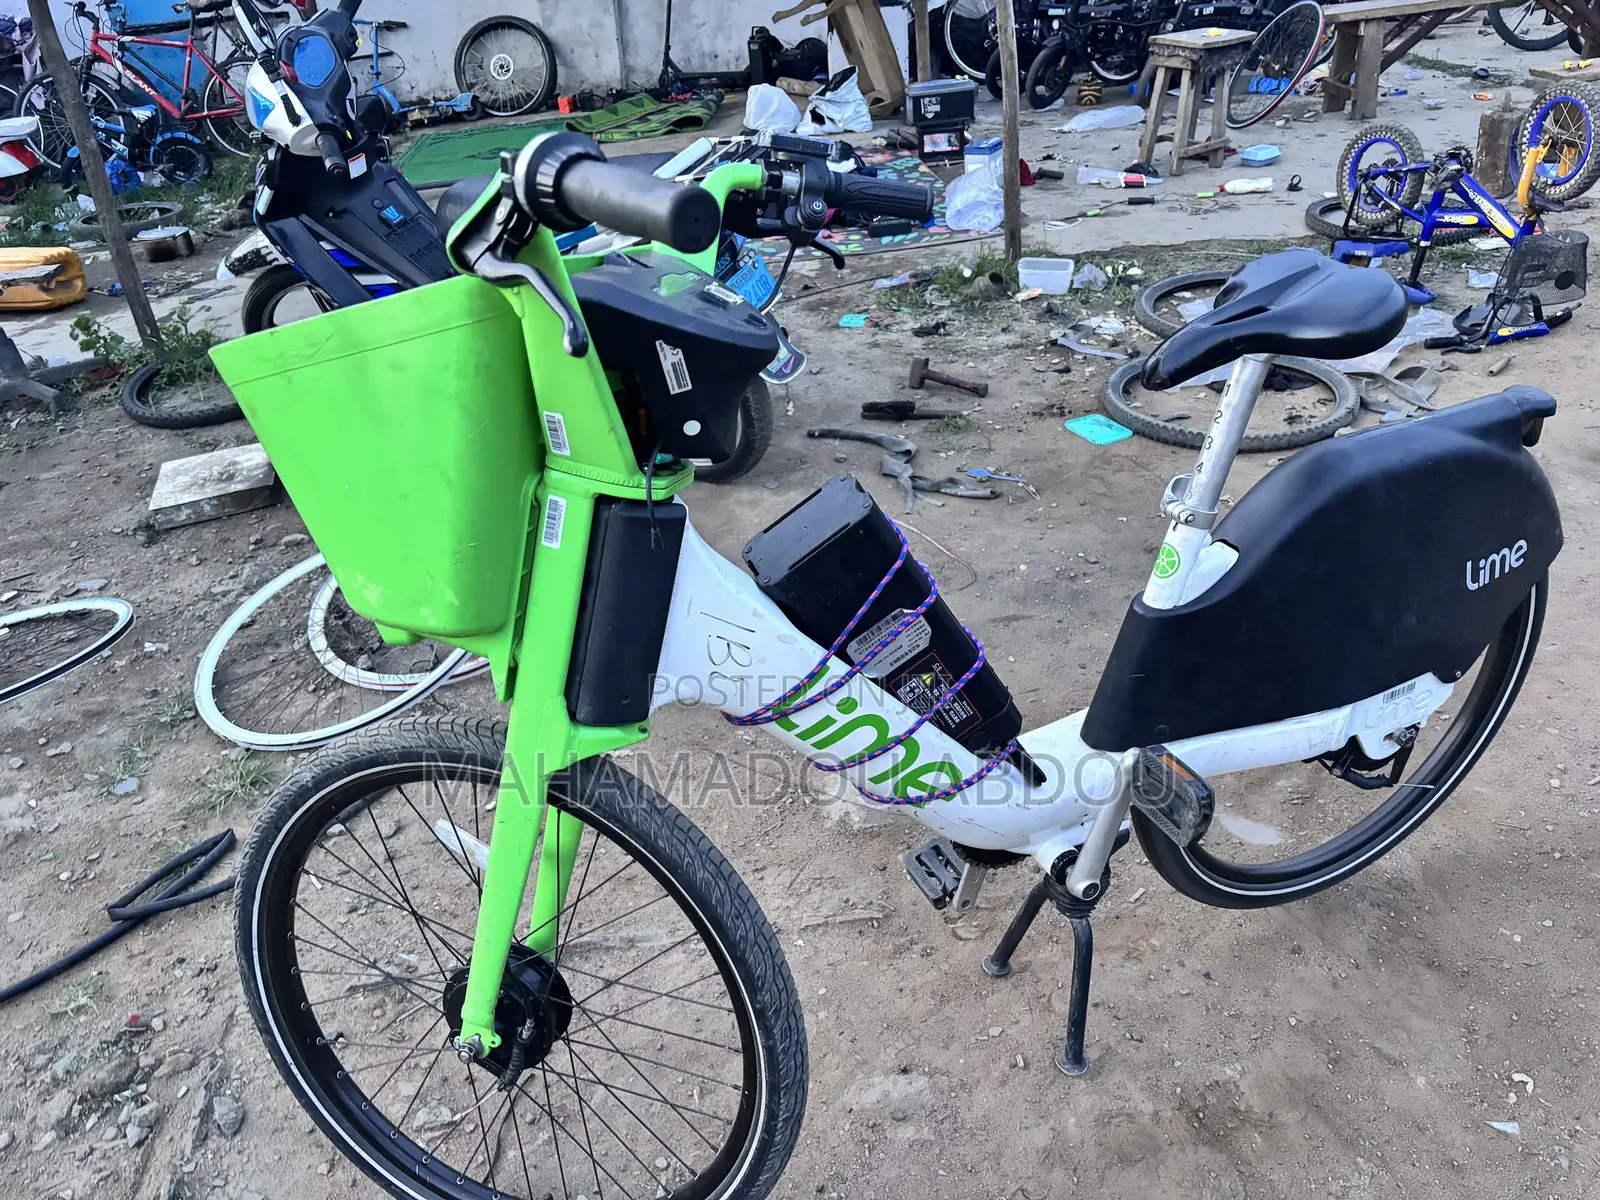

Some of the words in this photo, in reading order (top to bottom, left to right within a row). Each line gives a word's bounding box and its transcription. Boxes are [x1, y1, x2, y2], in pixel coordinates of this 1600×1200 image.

[1225, 383, 1232, 398] 1
[1213, 409, 1223, 424] 2
[1203, 435, 1214, 450] 3
[1195, 461, 1204, 475] 4
[1466, 539, 1528, 591] Lime
